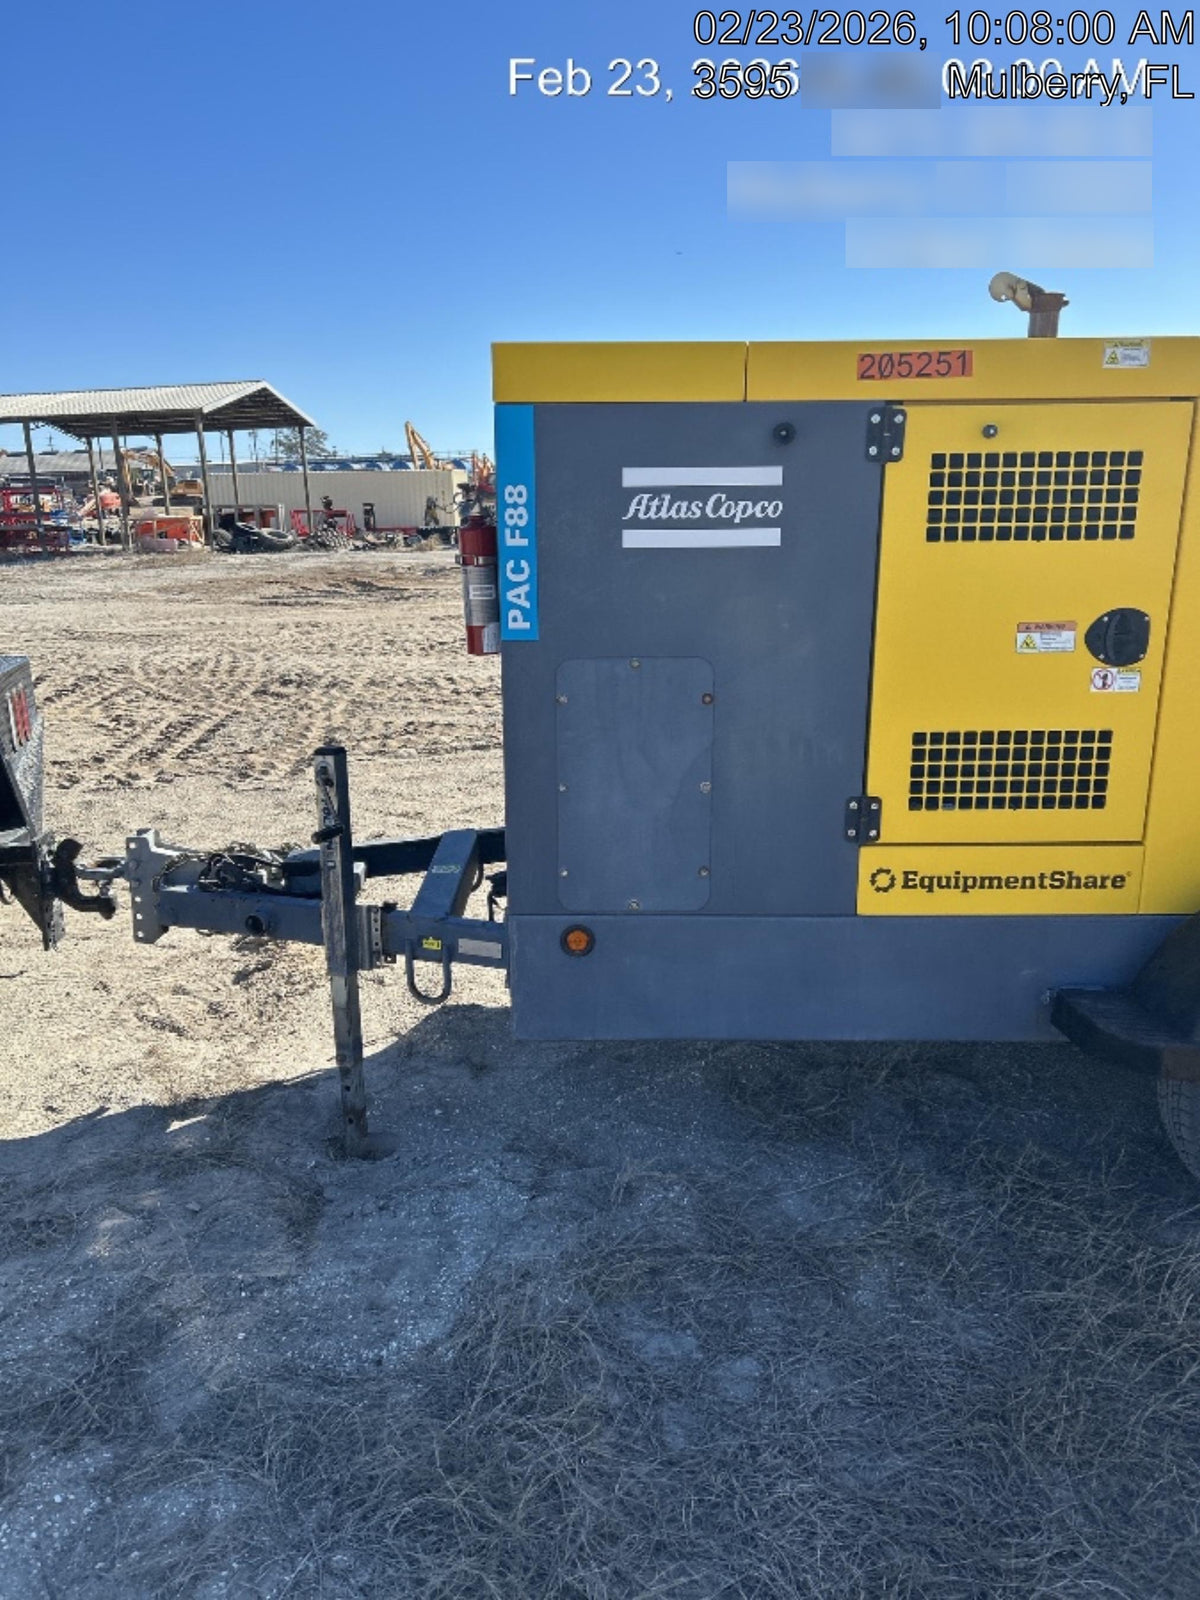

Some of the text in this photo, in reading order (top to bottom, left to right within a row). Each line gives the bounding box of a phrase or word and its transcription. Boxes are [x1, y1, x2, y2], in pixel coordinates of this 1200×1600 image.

[859, 350, 970, 379] 205251
[622, 493, 783, 523] Atlas Copco
[504, 484, 531, 630] PAC F88
[901, 870, 1127, 893] EquipmentShare
